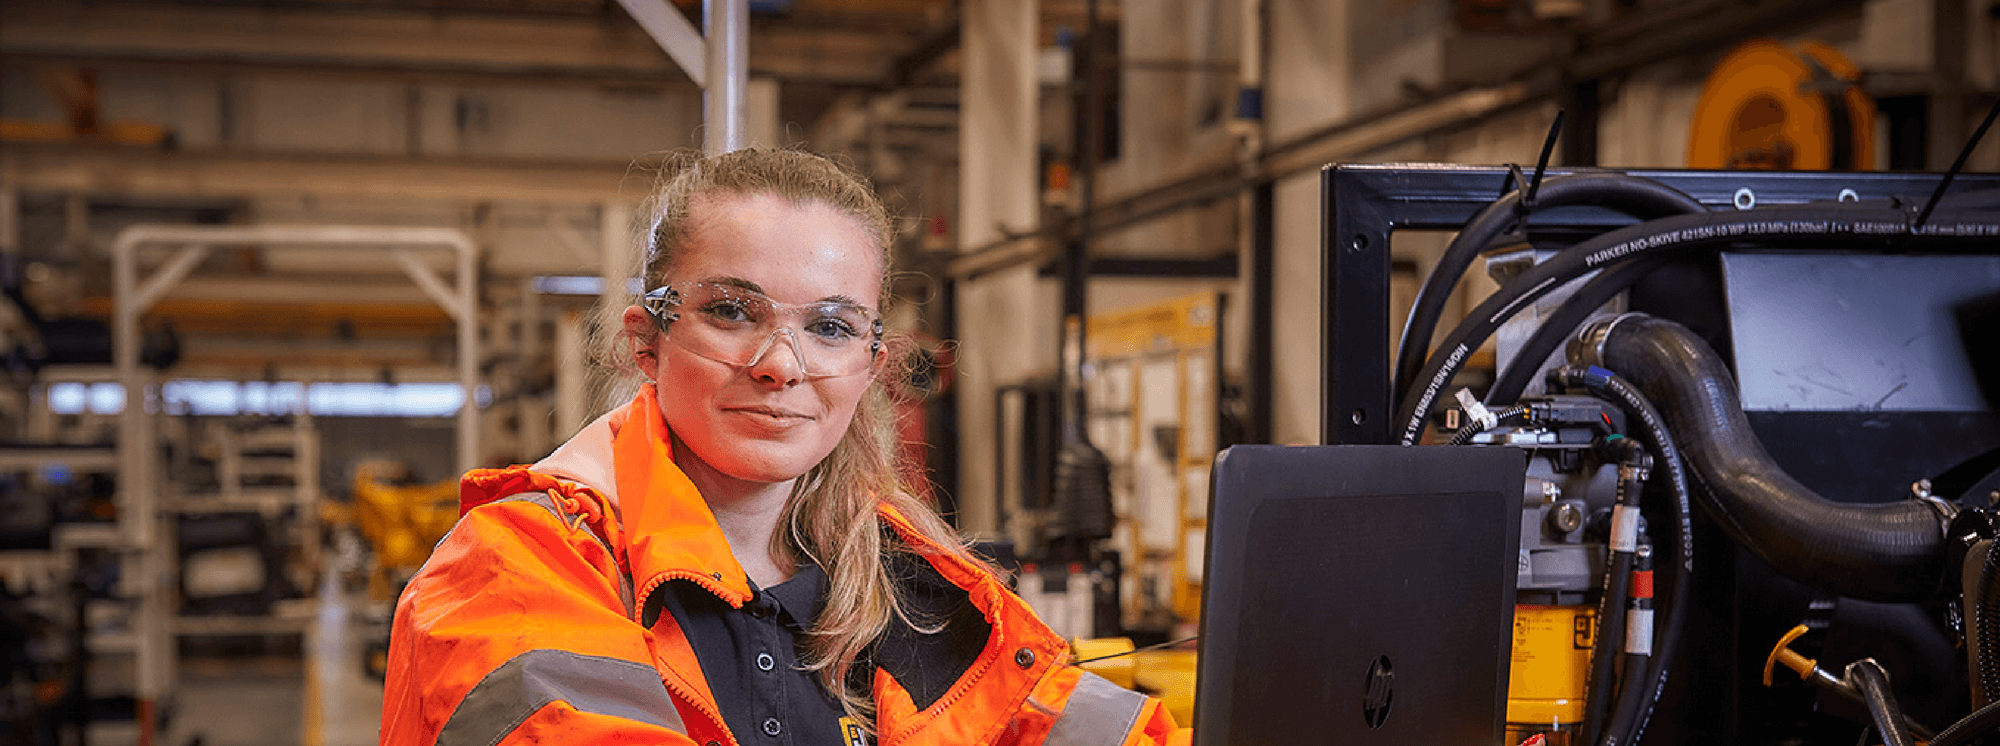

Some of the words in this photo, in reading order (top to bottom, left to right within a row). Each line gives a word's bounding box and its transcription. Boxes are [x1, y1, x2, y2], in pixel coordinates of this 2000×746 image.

[1585, 243, 1629, 266] PARKER
[1629, 231, 1680, 251] NO-SKIVE
[1729, 223, 1746, 236] WP
